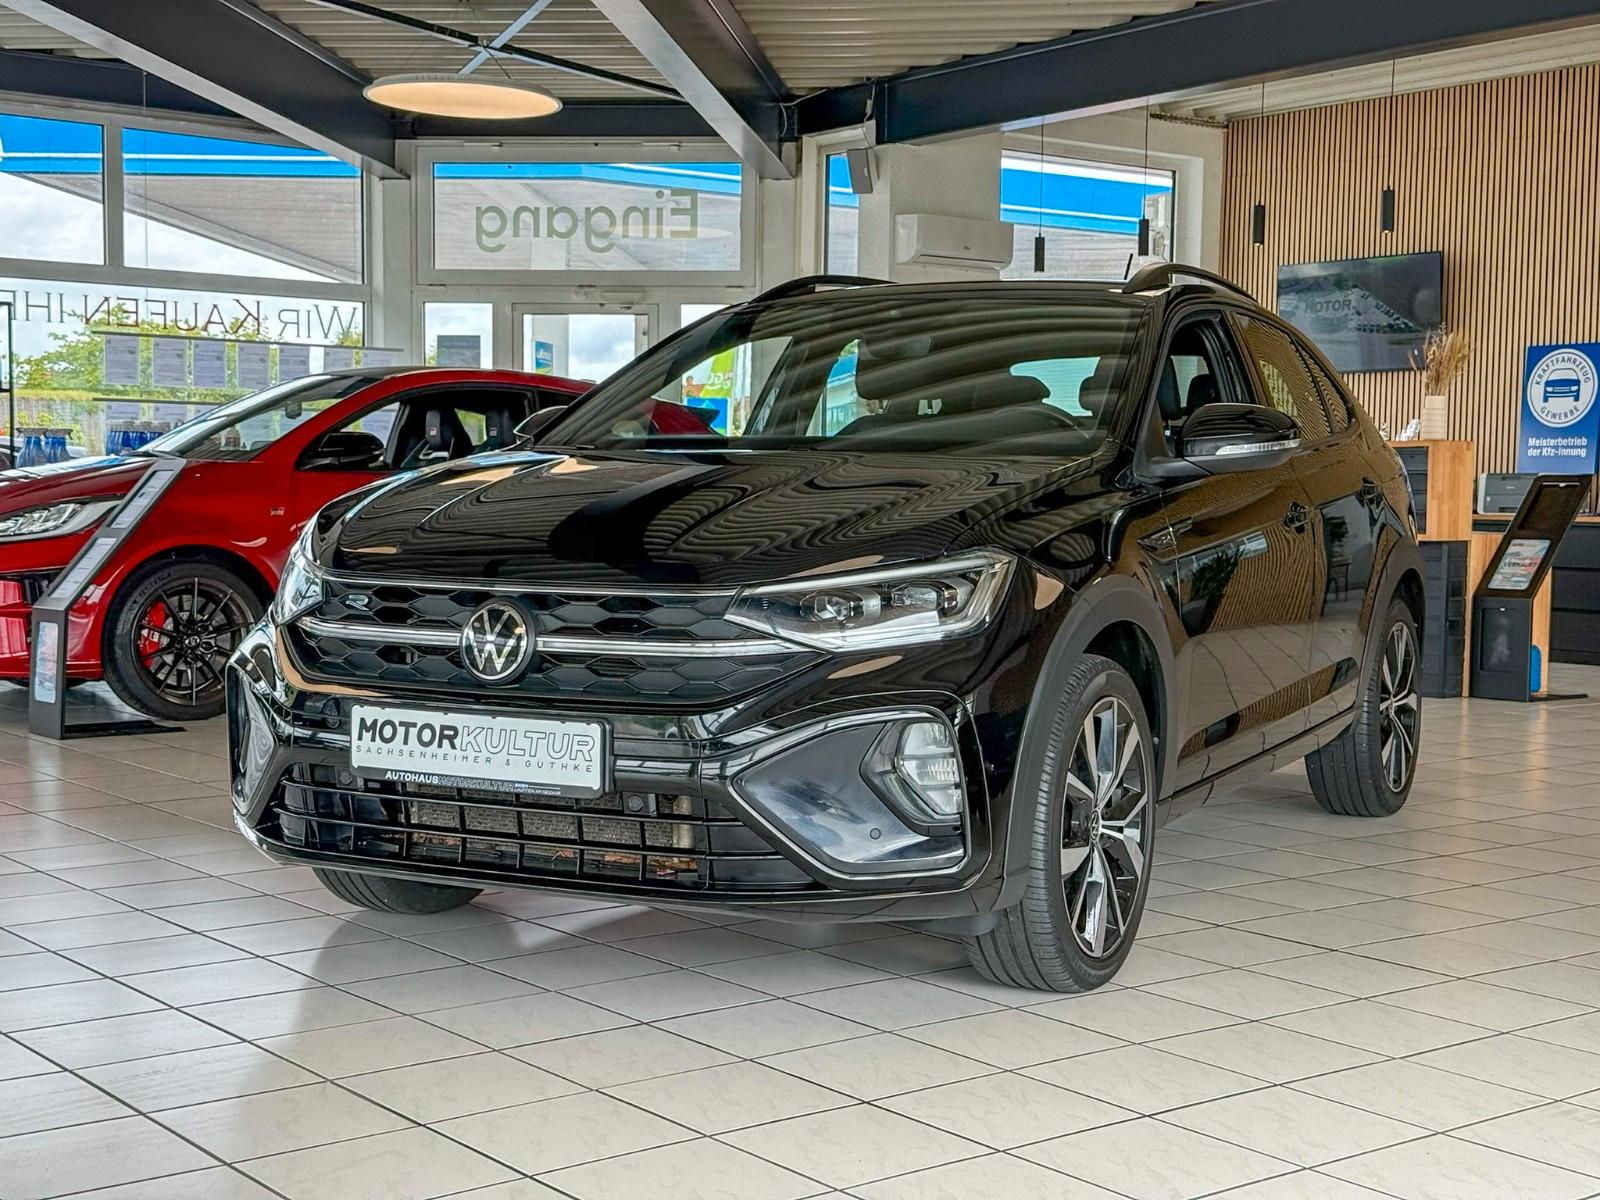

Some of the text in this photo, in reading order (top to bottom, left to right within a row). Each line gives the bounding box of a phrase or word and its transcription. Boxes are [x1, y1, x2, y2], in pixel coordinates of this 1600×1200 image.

[1534, 355, 1591, 386] KRAFTFAHRZEUG
[1540, 405, 1580, 420] GEWERBE
[1528, 436, 1588, 447] Meisterbetrieb
[1527, 446, 1587, 458] der Kfz-Innung
[356, 745, 593, 773] SACHSENHEIMER & GUTHKE
